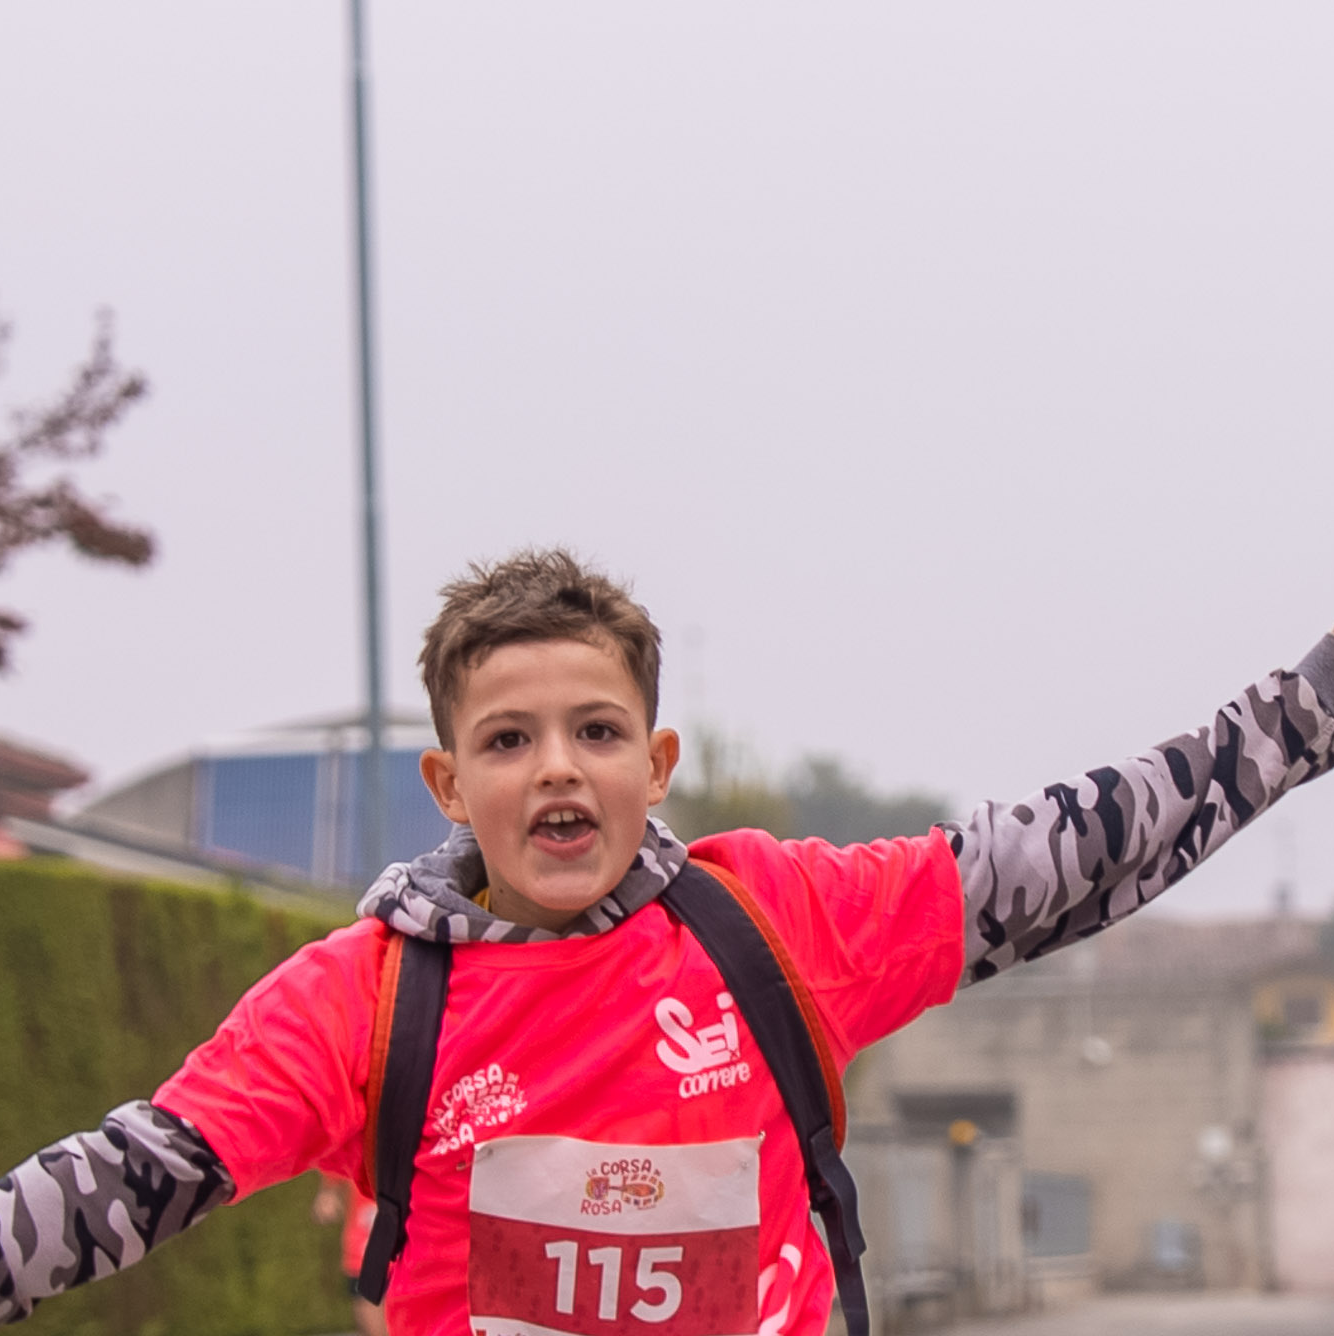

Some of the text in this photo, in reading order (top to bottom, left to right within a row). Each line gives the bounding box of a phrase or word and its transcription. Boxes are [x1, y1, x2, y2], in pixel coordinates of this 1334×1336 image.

[600, 1159, 652, 1176] CORSA
[580, 1199, 622, 1216] ROSA
[545, 1240, 683, 1323] 115
